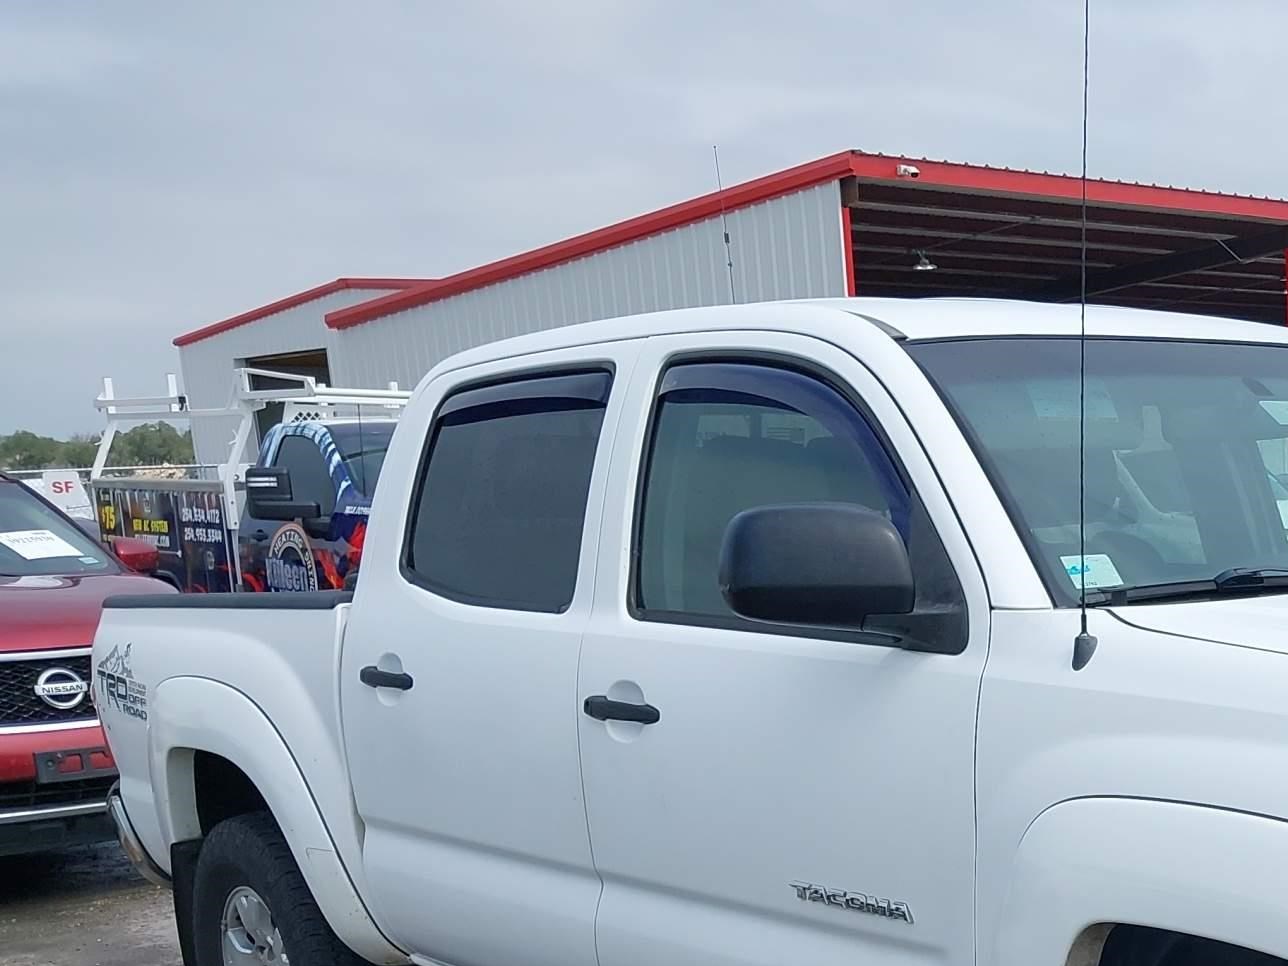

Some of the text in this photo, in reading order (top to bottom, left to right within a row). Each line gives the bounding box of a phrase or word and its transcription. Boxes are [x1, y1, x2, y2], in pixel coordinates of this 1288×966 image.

[51, 481, 74, 494] SF
[274, 531, 304, 554] HEATING
[265, 557, 309, 592] Killeen
[42, 684, 83, 694] NISSAN
[128, 693, 147, 707] OFF
[122, 703, 148, 721] ROAD
[788, 879, 916, 925] TACOMA
